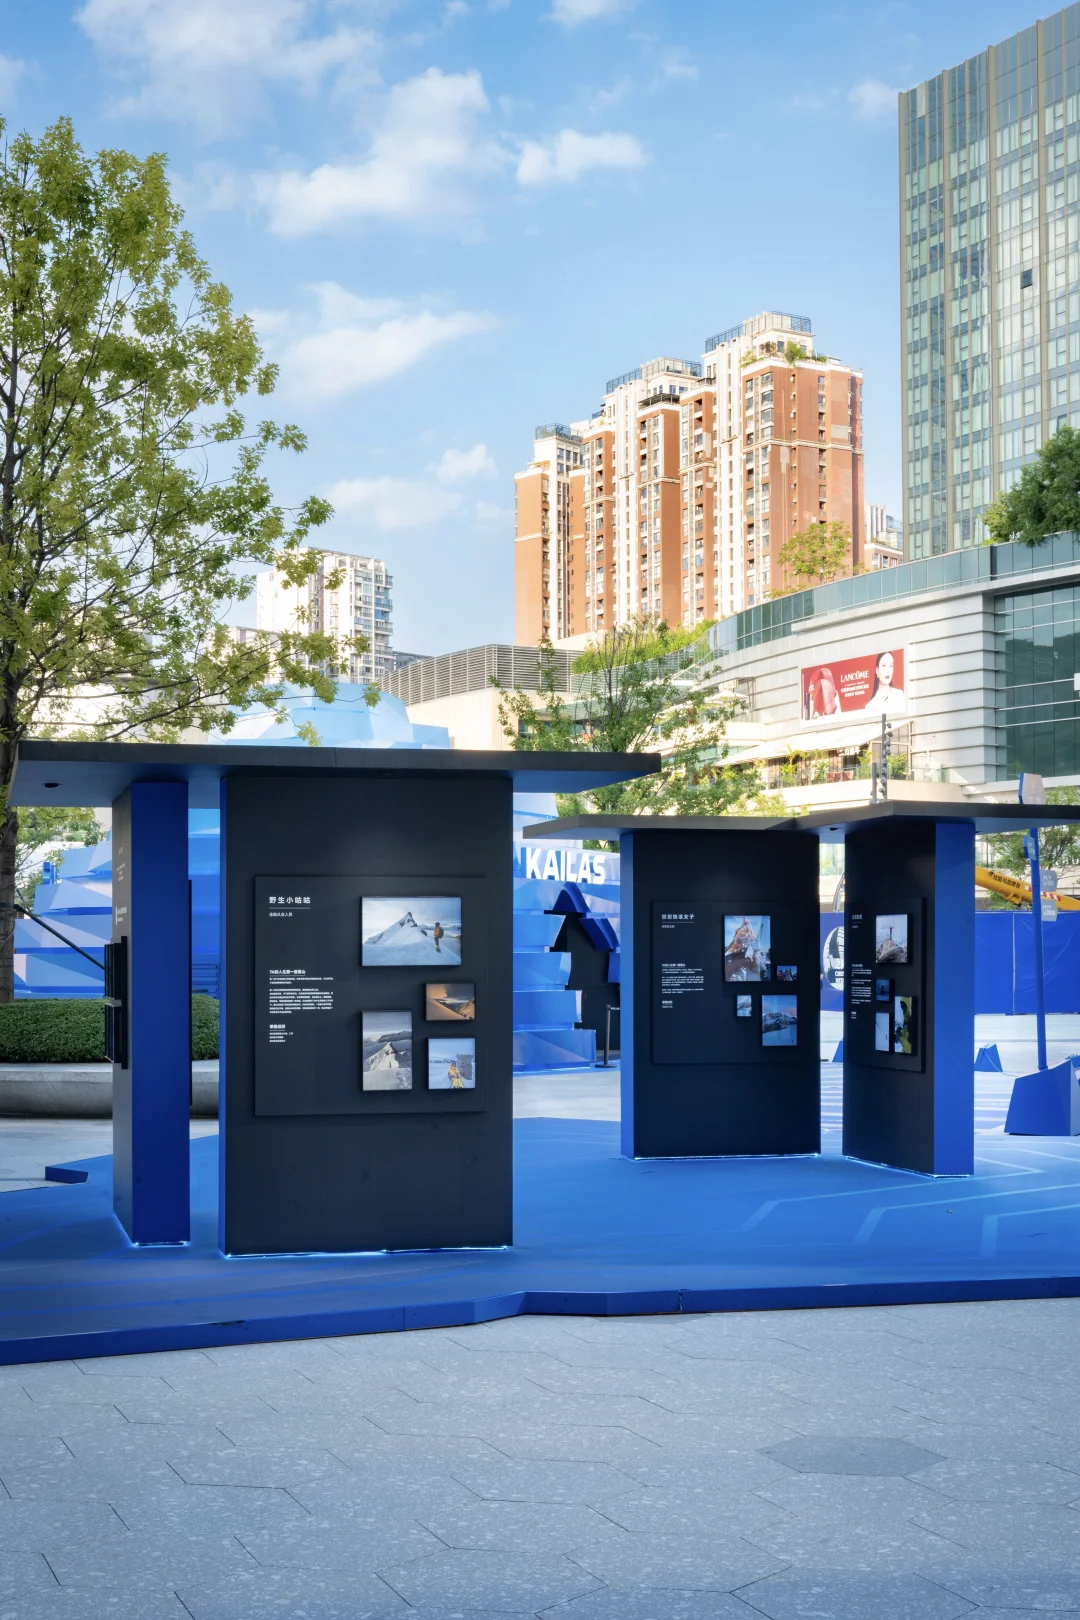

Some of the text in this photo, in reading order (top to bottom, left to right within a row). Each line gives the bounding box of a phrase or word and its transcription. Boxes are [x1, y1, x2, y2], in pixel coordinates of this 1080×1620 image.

[840, 670, 870, 683] LANCÔME
[525, 847, 606, 884] KAILAS
[269, 896, 311, 904] 野生小咕咕
